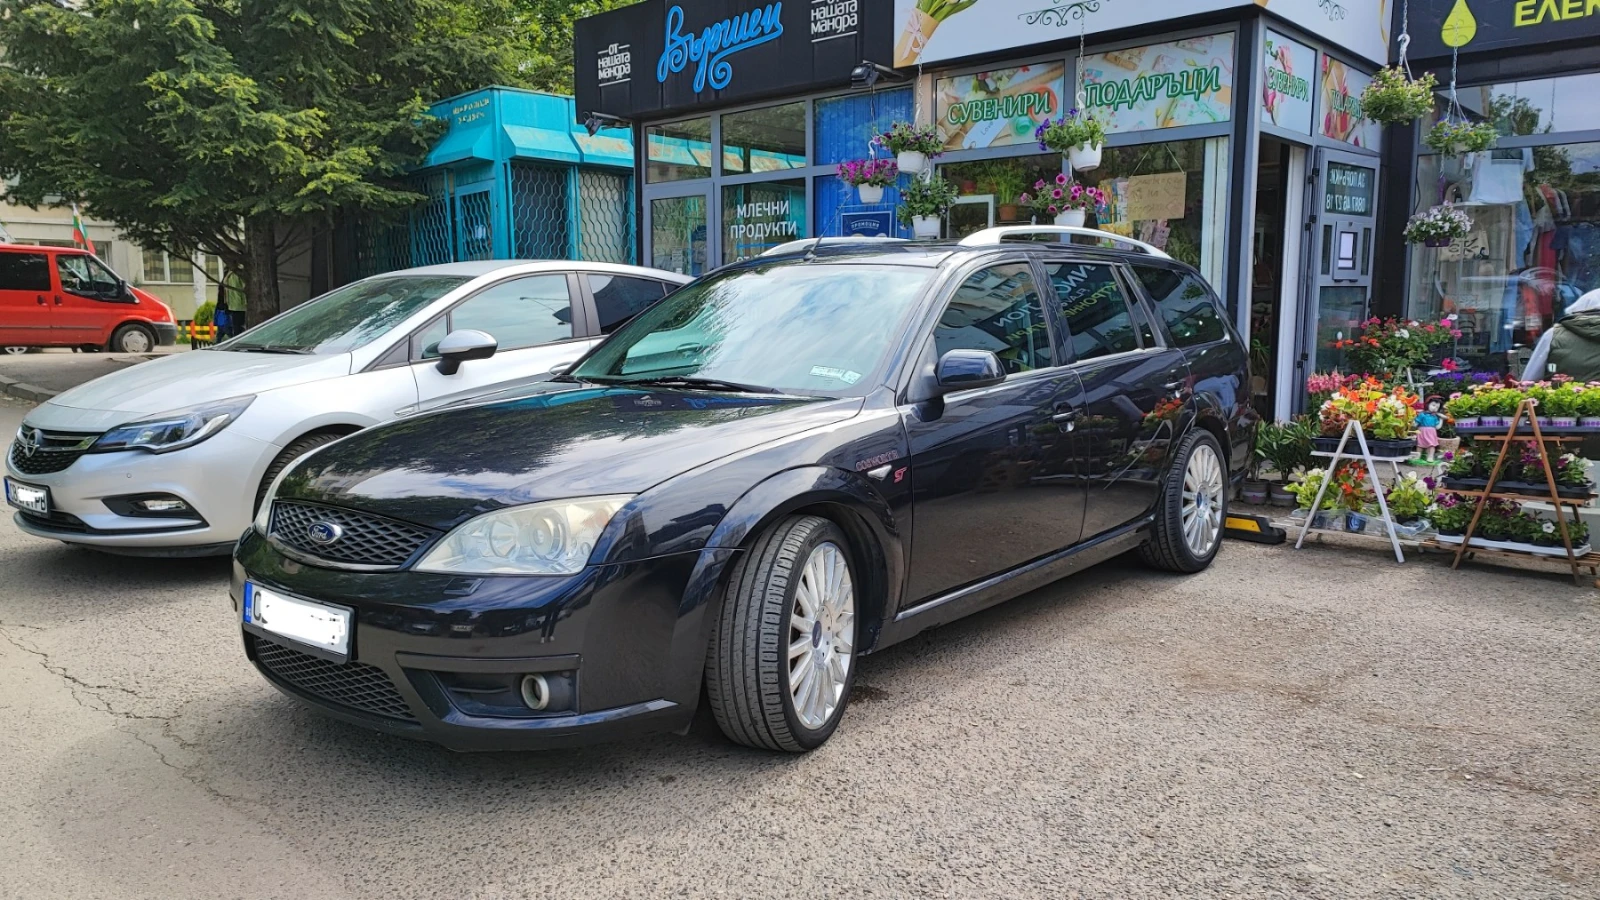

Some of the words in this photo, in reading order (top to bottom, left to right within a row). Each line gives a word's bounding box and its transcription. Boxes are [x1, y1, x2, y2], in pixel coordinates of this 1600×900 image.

[811, 13, 857, 35] мандра
[1085, 65, 1220, 111] ПОДАРЪЦИ
[948, 90, 1051, 125] СУВЕНИРИ
[736, 200, 790, 219] МЛЕЧНИ
[730, 221, 797, 241] ПРОДУКТИ
[311, 525, 329, 540] Ford
